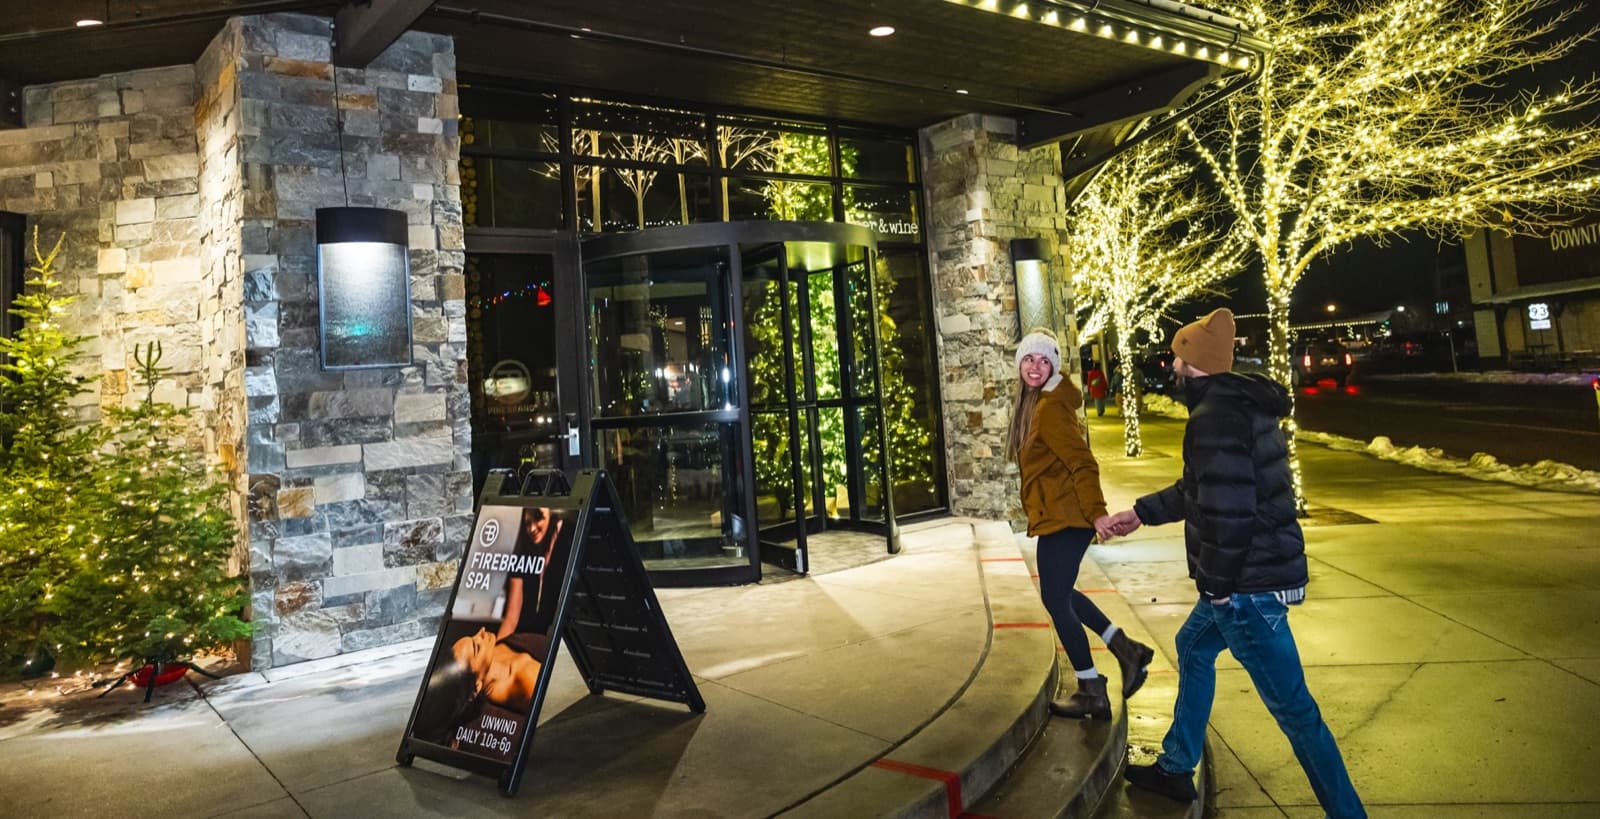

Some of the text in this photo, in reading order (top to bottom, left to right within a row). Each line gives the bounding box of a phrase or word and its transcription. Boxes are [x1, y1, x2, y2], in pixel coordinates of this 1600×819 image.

[889, 219, 919, 234] wine
[1550, 223, 1600, 251] DOWNT
[1531, 306, 1547, 317] 93
[471, 551, 546, 575] FIREBRAND
[465, 571, 491, 591] SPA
[480, 714, 517, 735] UNWIND
[455, 726, 481, 745] DAILY
